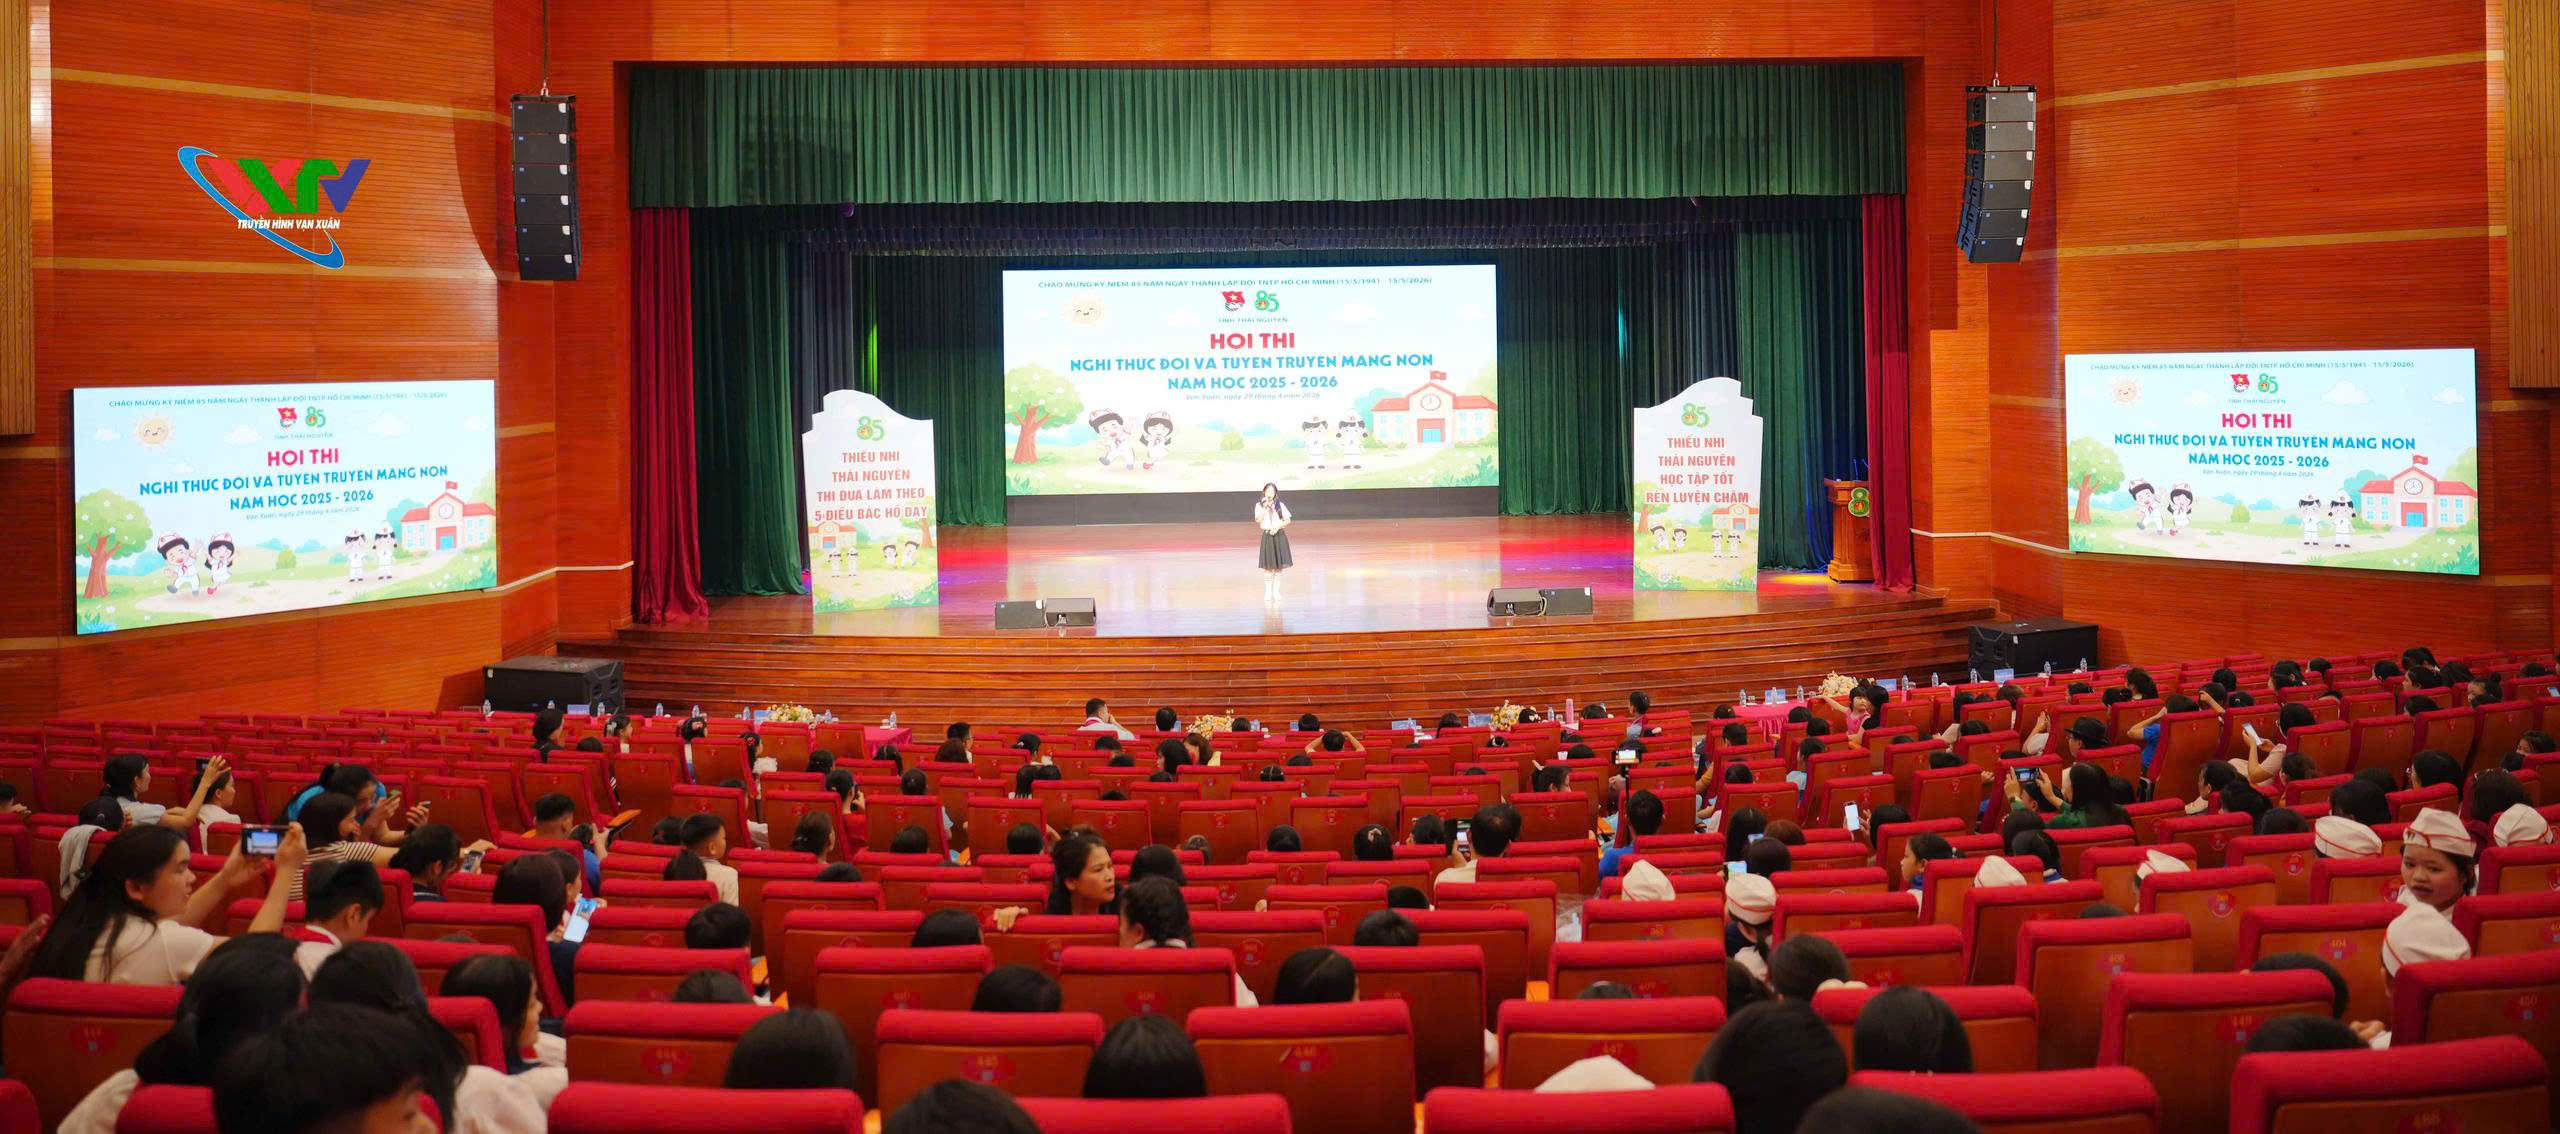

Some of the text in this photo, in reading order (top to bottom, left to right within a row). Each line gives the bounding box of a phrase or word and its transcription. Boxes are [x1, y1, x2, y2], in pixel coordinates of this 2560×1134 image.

[1258, 332, 1295, 350] THI
[1249, 376, 1287, 389] 2025
[1299, 375, 1338, 388] 2026
[2258, 373, 2279, 394] 85
[305, 406, 326, 428] 85
[1681, 402, 1710, 428] 85
[2261, 413, 2293, 429] THI
[857, 416, 885, 441] 85
[1667, 434, 1725, 448] THIẾU NHI
[309, 448, 339, 464] THI
[842, 449, 900, 463] THIẾU NHI
[1658, 453, 1736, 467] THÁI NGUYÊN
[2254, 455, 2285, 467] 2025
[2297, 456, 2329, 467] 2026
[832, 469, 858, 483] THÁI
[1660, 470, 1734, 487] HỌC TẬP TỐT
[301, 492, 332, 505] 2025
[343, 490, 374, 503] 2026
[817, 486, 925, 503] THI ĐUA LÀM THEO
[1646, 489, 1749, 505] RÈN LUYỆN CHĂM
[815, 510, 821, 522] 5
[857, 505, 881, 520] BÁC
[904, 505, 928, 519] DẠY
